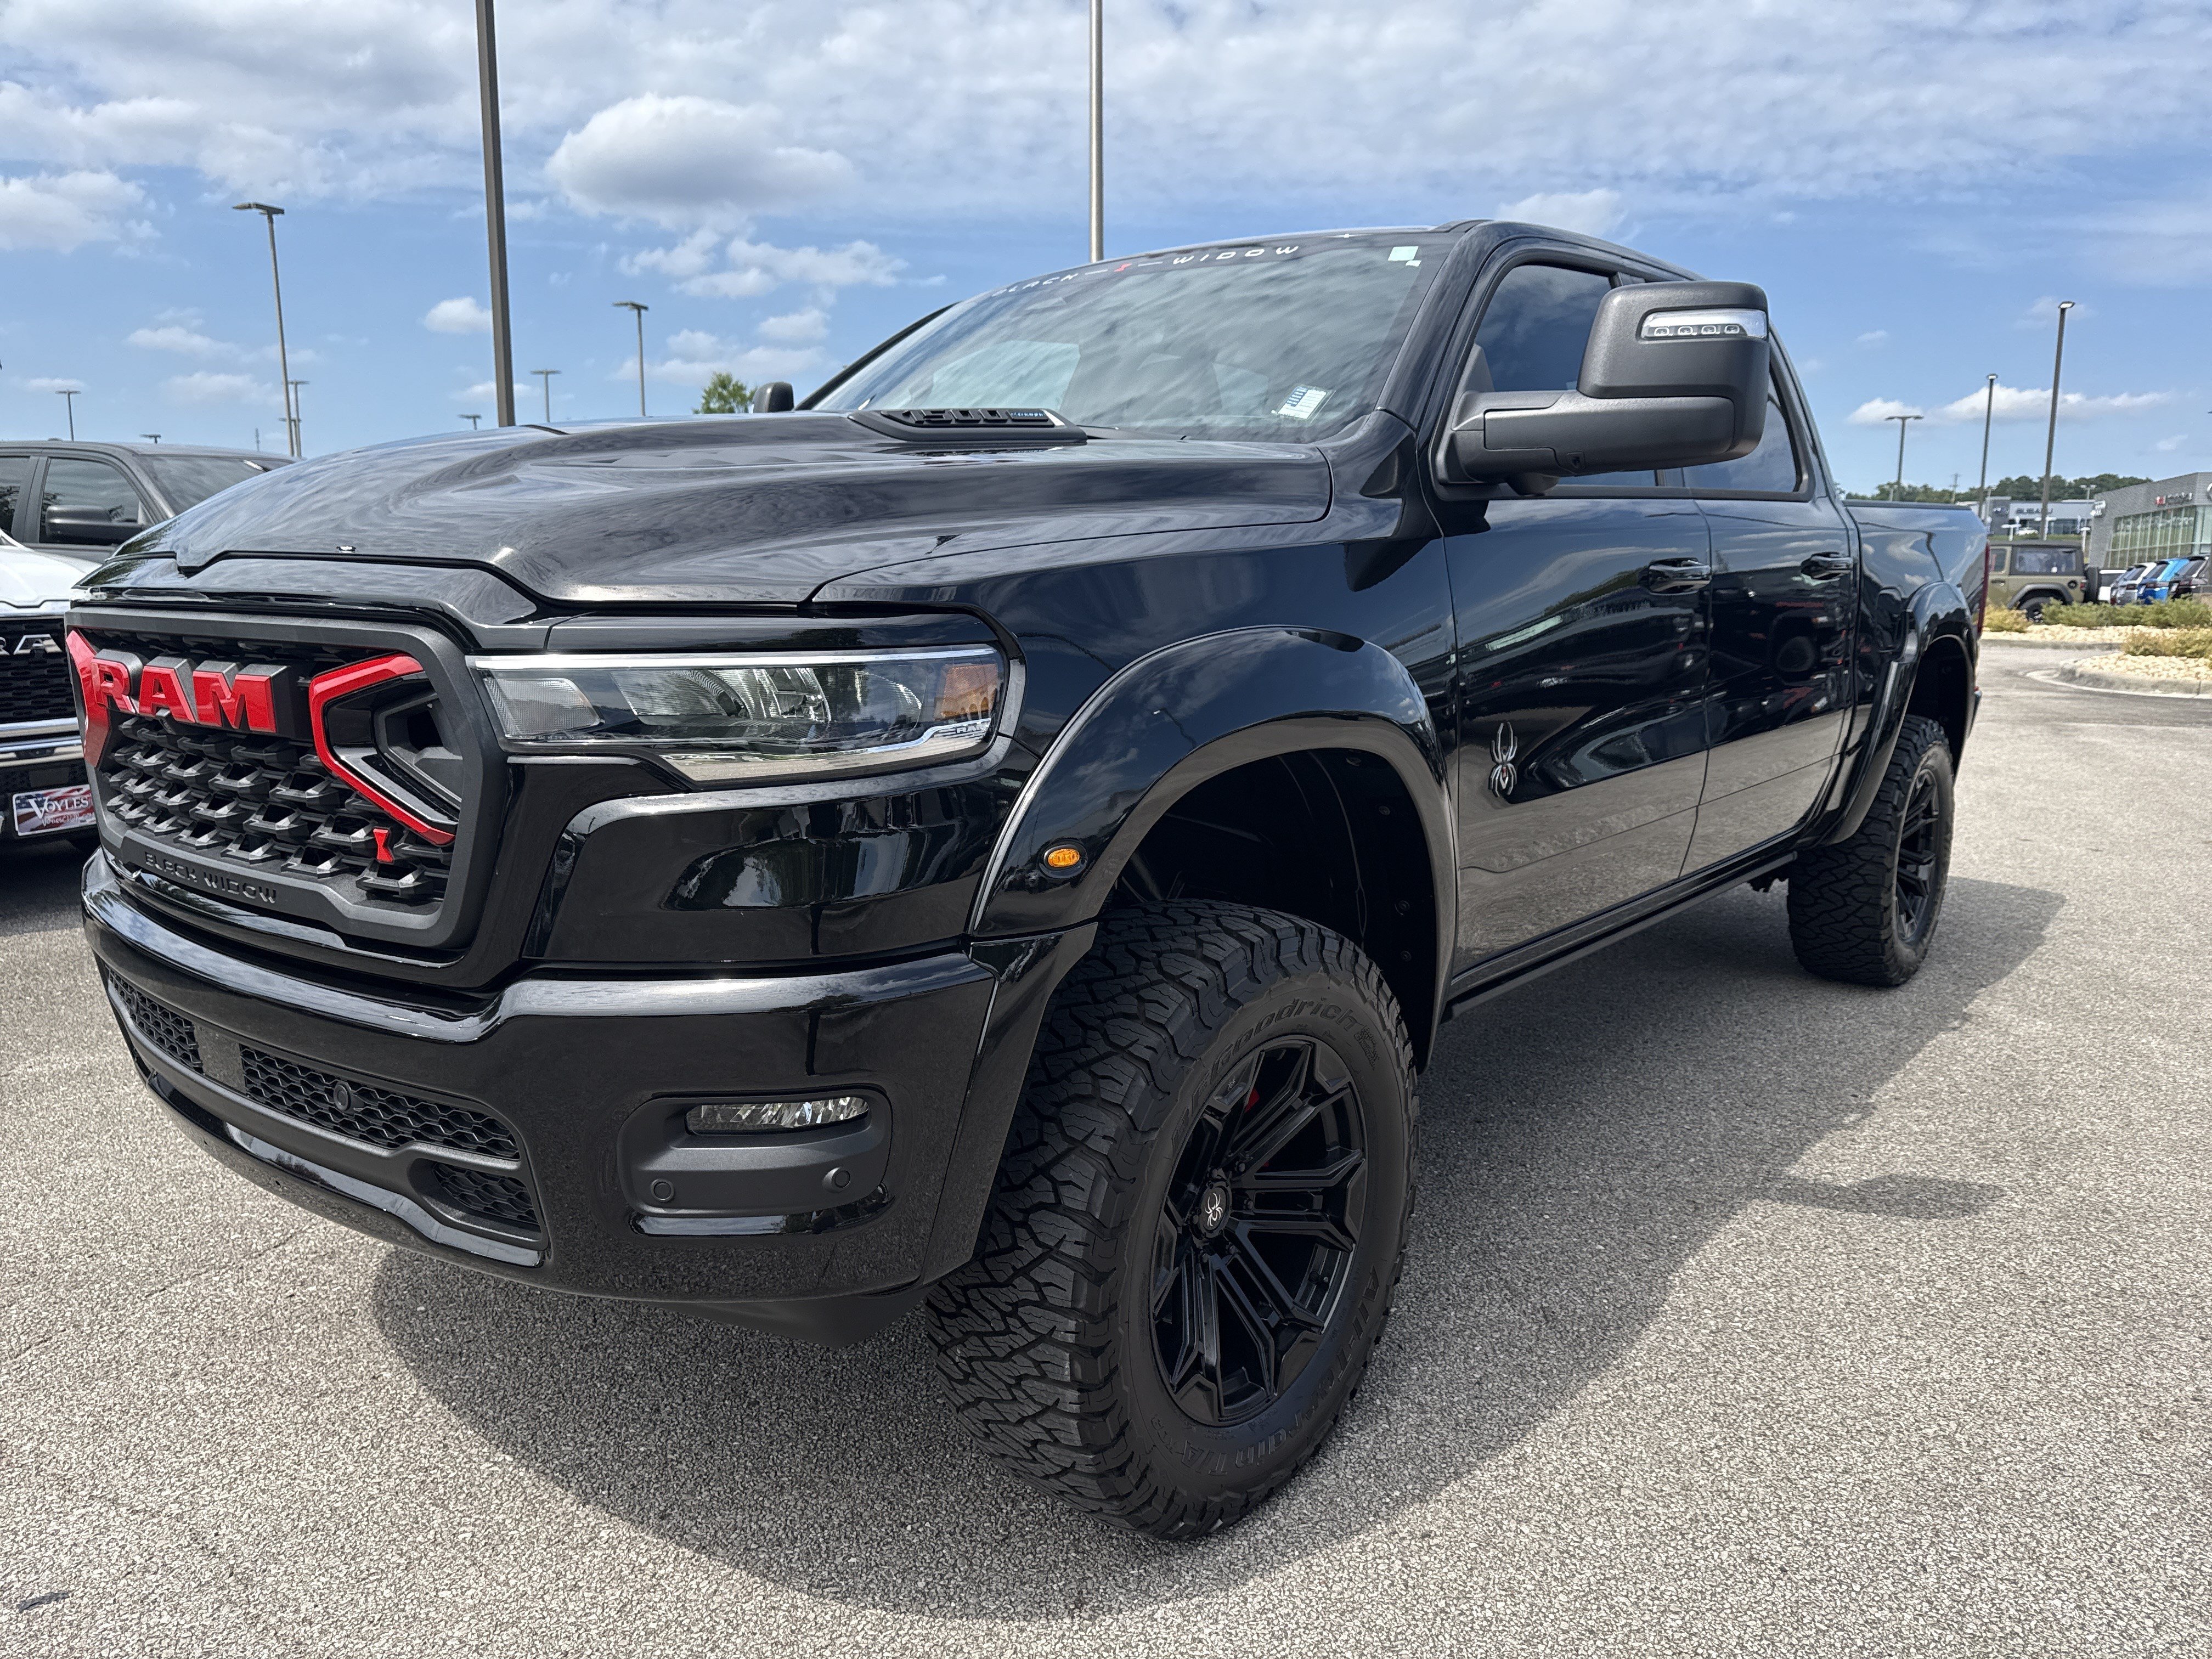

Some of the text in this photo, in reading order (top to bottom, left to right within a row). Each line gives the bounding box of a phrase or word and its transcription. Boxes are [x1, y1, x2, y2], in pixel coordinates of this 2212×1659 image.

[1173, 246, 1299, 264] WIDOW
[90, 654, 279, 733] RAM
[144, 851, 276, 904] BLACK WIDOW
